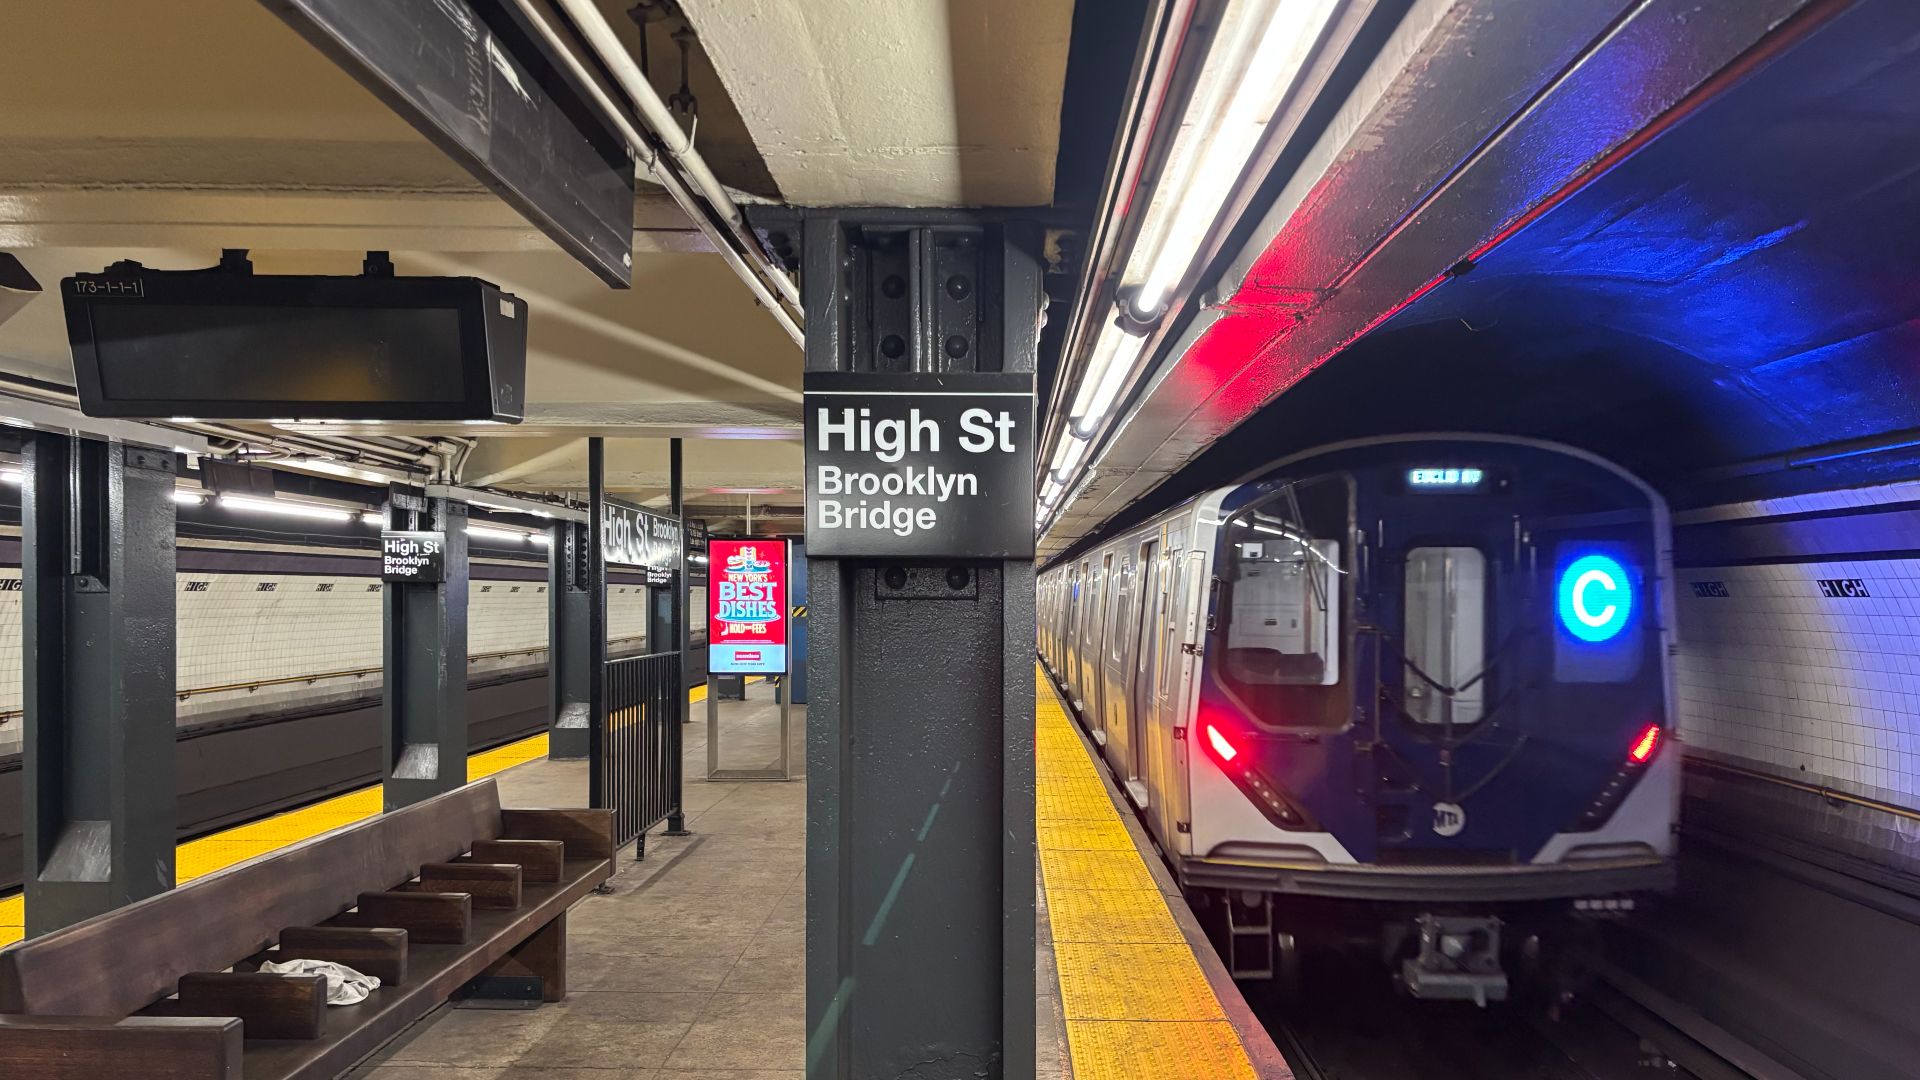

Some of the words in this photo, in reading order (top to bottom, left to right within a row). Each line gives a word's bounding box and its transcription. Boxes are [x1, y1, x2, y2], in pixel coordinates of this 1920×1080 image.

[75, 281, 138, 294] 173-1-1-1
[817, 408, 940, 463] High
[958, 408, 1016, 453] St
[817, 466, 978, 502] Brooklyn
[817, 500, 937, 537] Bridge
[602, 505, 631, 553] High
[636, 512, 649, 554] St
[384, 540, 419, 556] High
[423, 540, 440, 554] St
[384, 556, 430, 567] Brooklyn
[384, 565, 418, 576] Bridge
[728, 573, 744, 582] NEW
[745, 573, 768, 582] YORK'S
[0, 580, 23, 590] HIG
[185, 582, 209, 591] HIGH
[256, 582, 277, 592] HIGH
[719, 582, 777, 600] BEST
[1694, 582, 1729, 597] HIGH
[1818, 580, 1869, 597] HIGH
[1572, 569, 1617, 627] C
[719, 600, 777, 618] DISHES
[729, 623, 745, 634] HOLD
[751, 623, 767, 634] FEES
